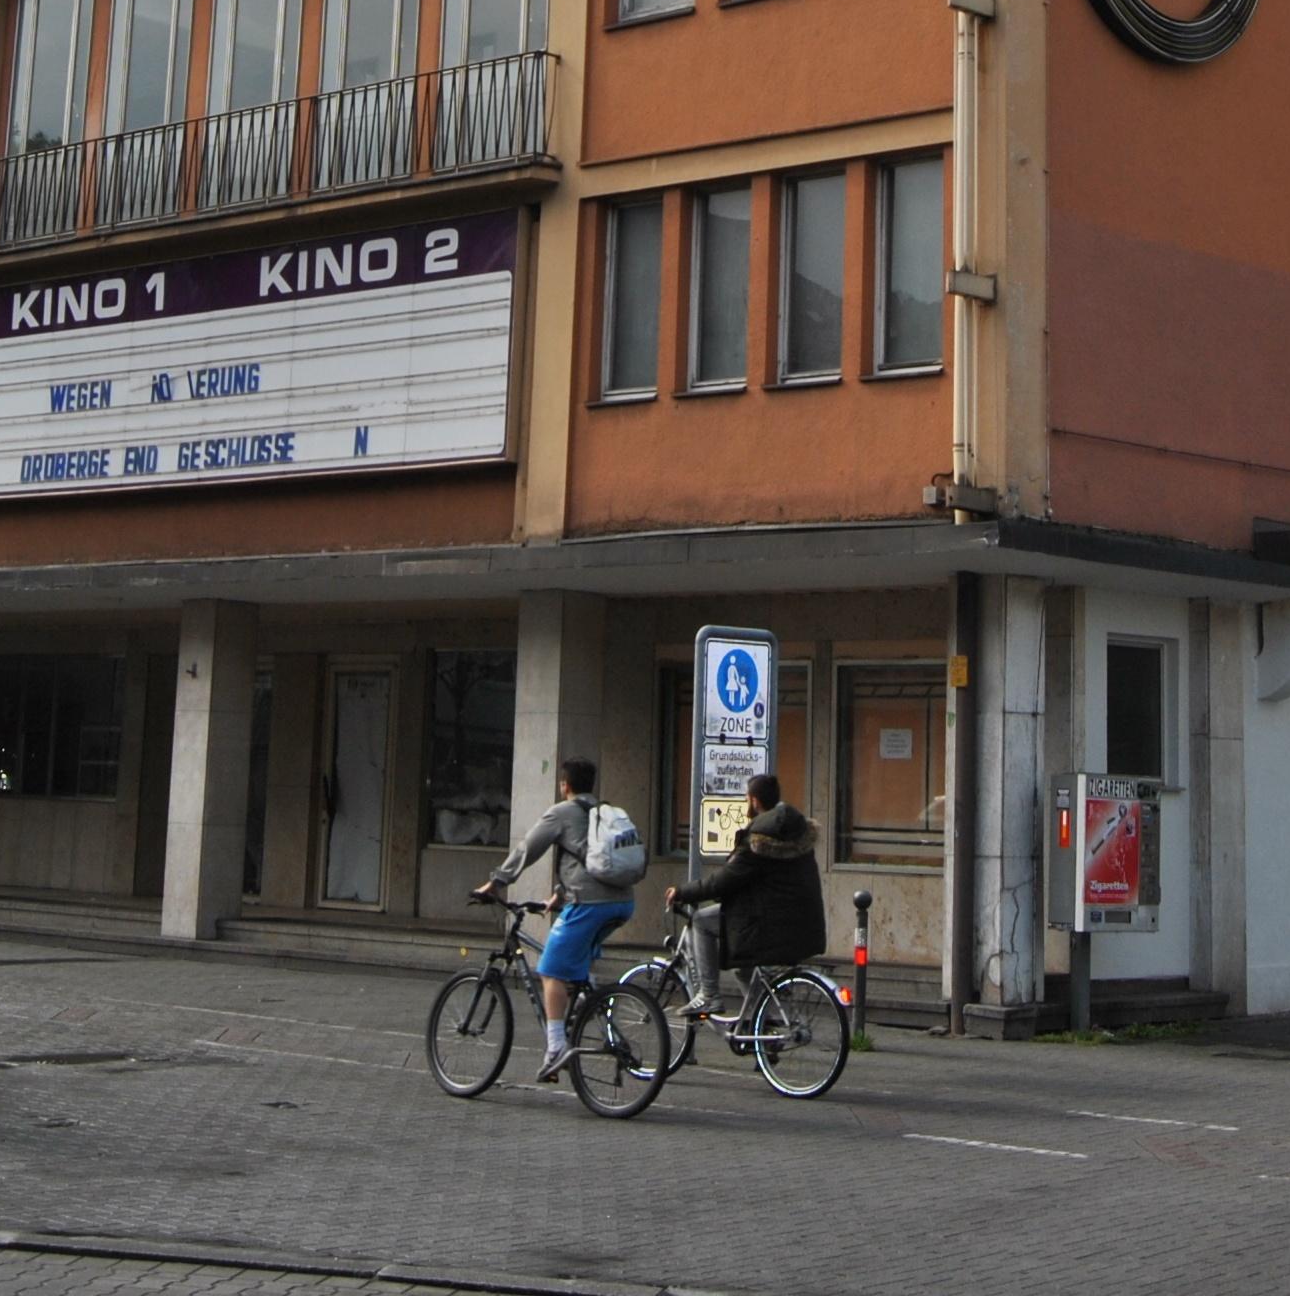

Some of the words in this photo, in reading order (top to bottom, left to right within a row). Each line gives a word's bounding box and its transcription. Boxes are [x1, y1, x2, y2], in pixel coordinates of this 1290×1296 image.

[12, 277, 127, 331] KINO
[145, 272, 166, 311] 1
[259, 237, 399, 297] KINO
[424, 228, 459, 273] 2
[50, 379, 112, 413] WEGEN
[124, 445, 158, 475] END
[354, 425, 369, 457] N
[720, 717, 752, 733] ZONE
[709, 749, 762, 765] Grundstücks-
[717, 764, 754, 777] zufahrten
[727, 778, 741, 791] frei
[1090, 778, 1135, 798] ZIGARETTEN
[1090, 881, 1129, 893] Zigaretten
